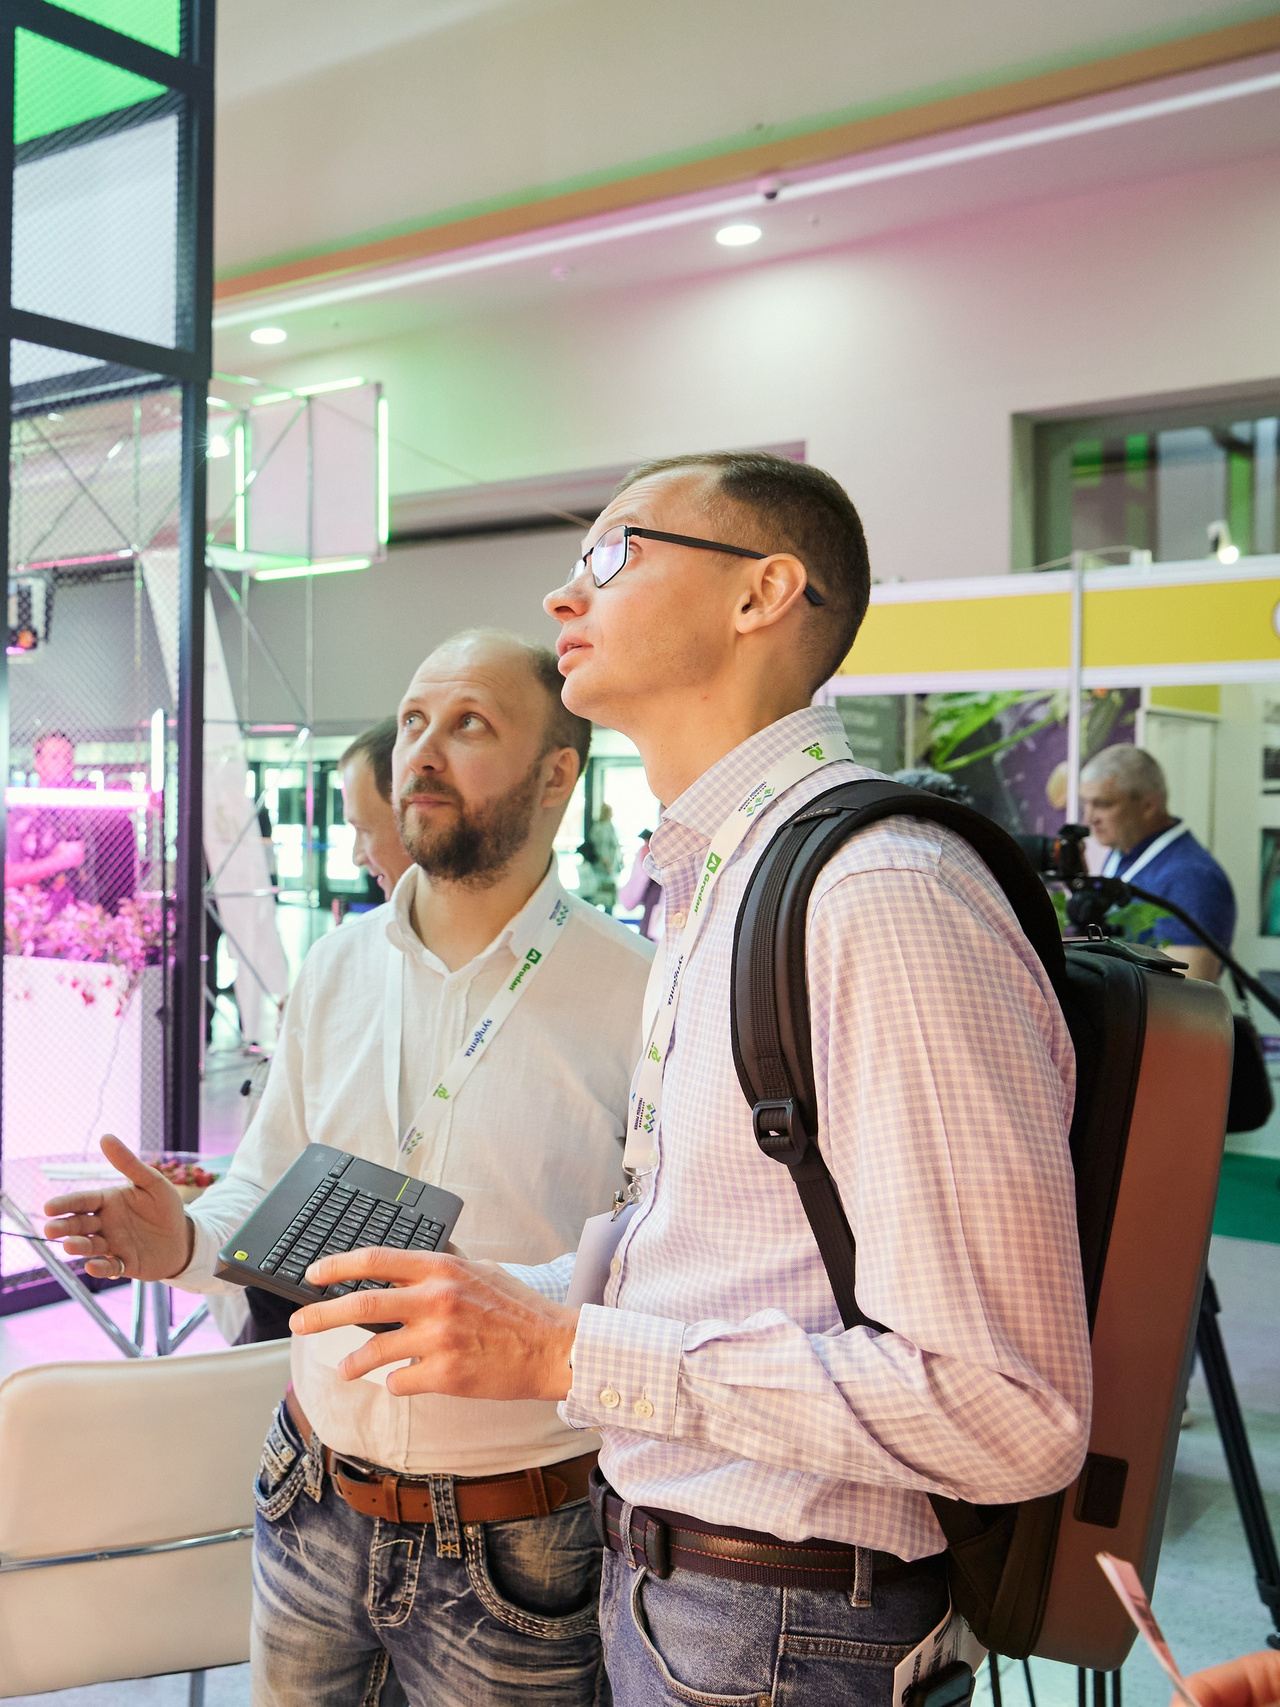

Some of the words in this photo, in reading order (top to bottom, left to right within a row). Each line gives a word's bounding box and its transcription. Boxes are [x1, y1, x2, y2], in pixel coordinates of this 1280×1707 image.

[694, 873, 710, 914] Grodan
[509, 963, 531, 991] Grodan
[667, 953, 685, 1006] syngenta
[464, 1018, 493, 1057] syngenta
